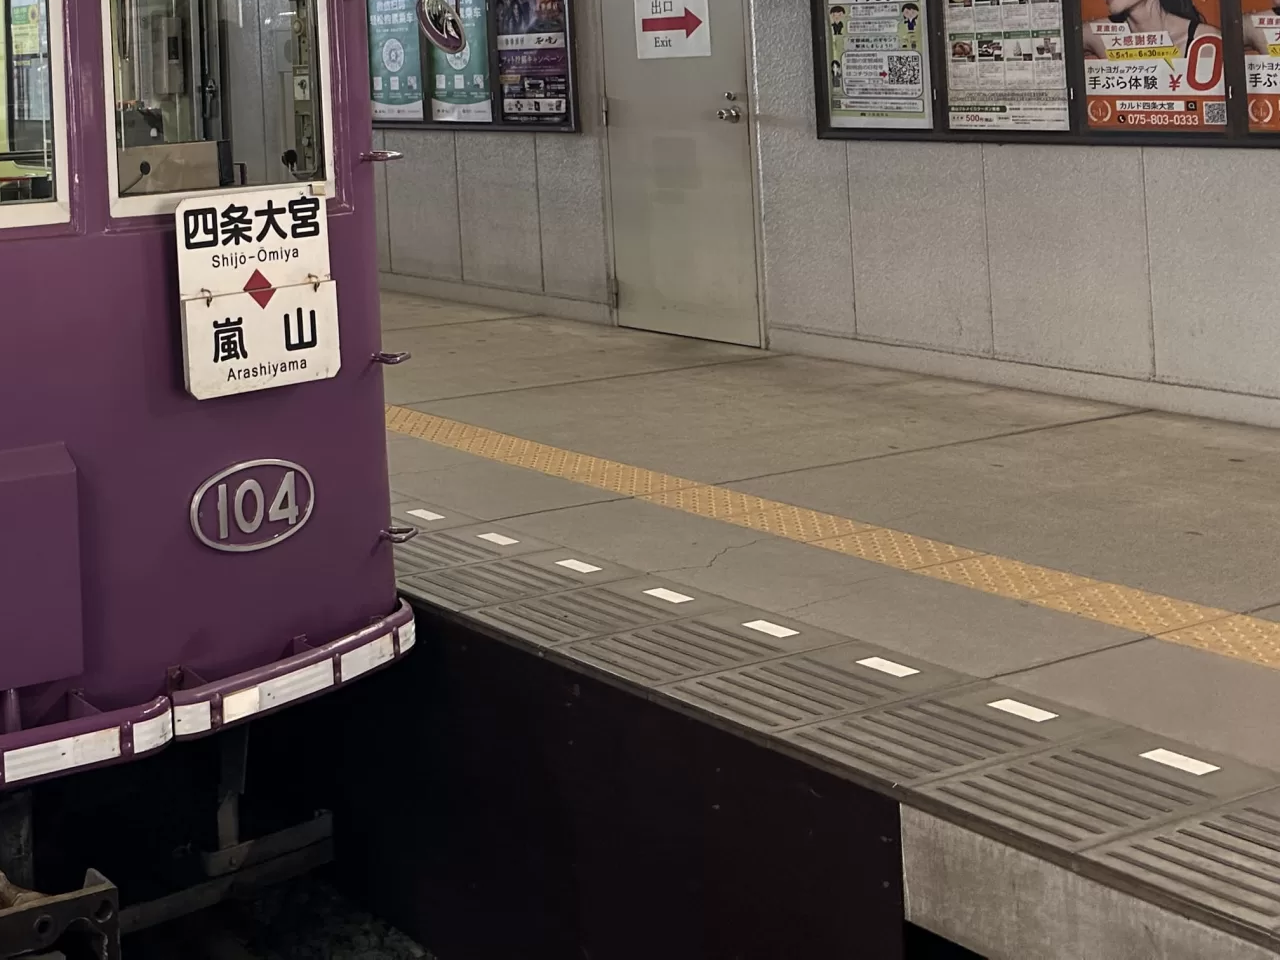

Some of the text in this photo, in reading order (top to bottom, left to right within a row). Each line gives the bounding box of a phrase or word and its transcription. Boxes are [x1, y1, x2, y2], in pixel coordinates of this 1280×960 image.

[651, 0, 673, 15] 出口
[654, 36, 672, 48] Exit
[1088, 76, 1158, 90] 手ぶら体験
[1120, 102, 1175, 110] カルド四条大宮
[1128, 114, 1199, 125] 075-803-0333
[183, 196, 321, 250] 四条大宮
[226, 357, 308, 382] Arashiyama
[217, 471, 299, 539] 104
